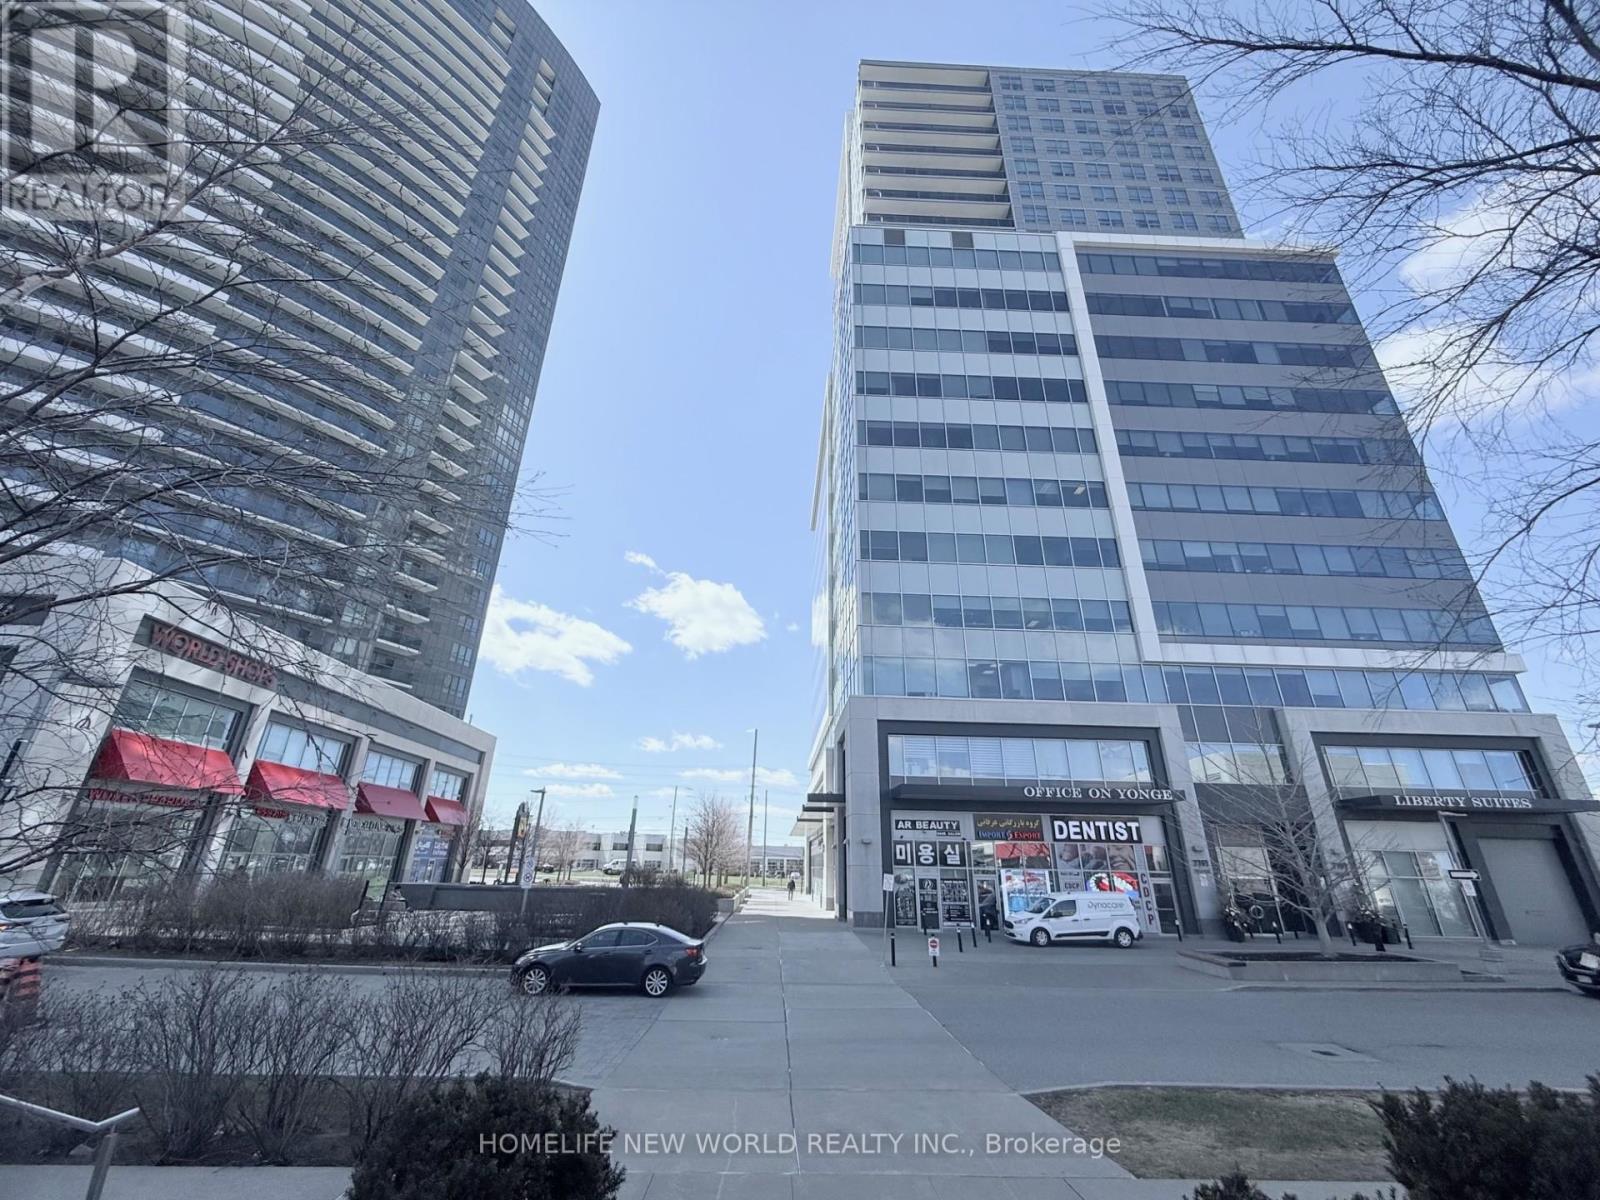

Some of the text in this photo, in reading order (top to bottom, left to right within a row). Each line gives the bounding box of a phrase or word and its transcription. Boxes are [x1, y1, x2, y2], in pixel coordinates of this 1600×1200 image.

[152, 623, 278, 690] WORLD SHOPS
[1024, 786, 1173, 800] OFFICE ON YONGE
[1394, 795, 1532, 808] LIBERTY SUITES
[897, 821, 958, 829] AR BEAUTY
[1053, 820, 1139, 840] DENTIST
